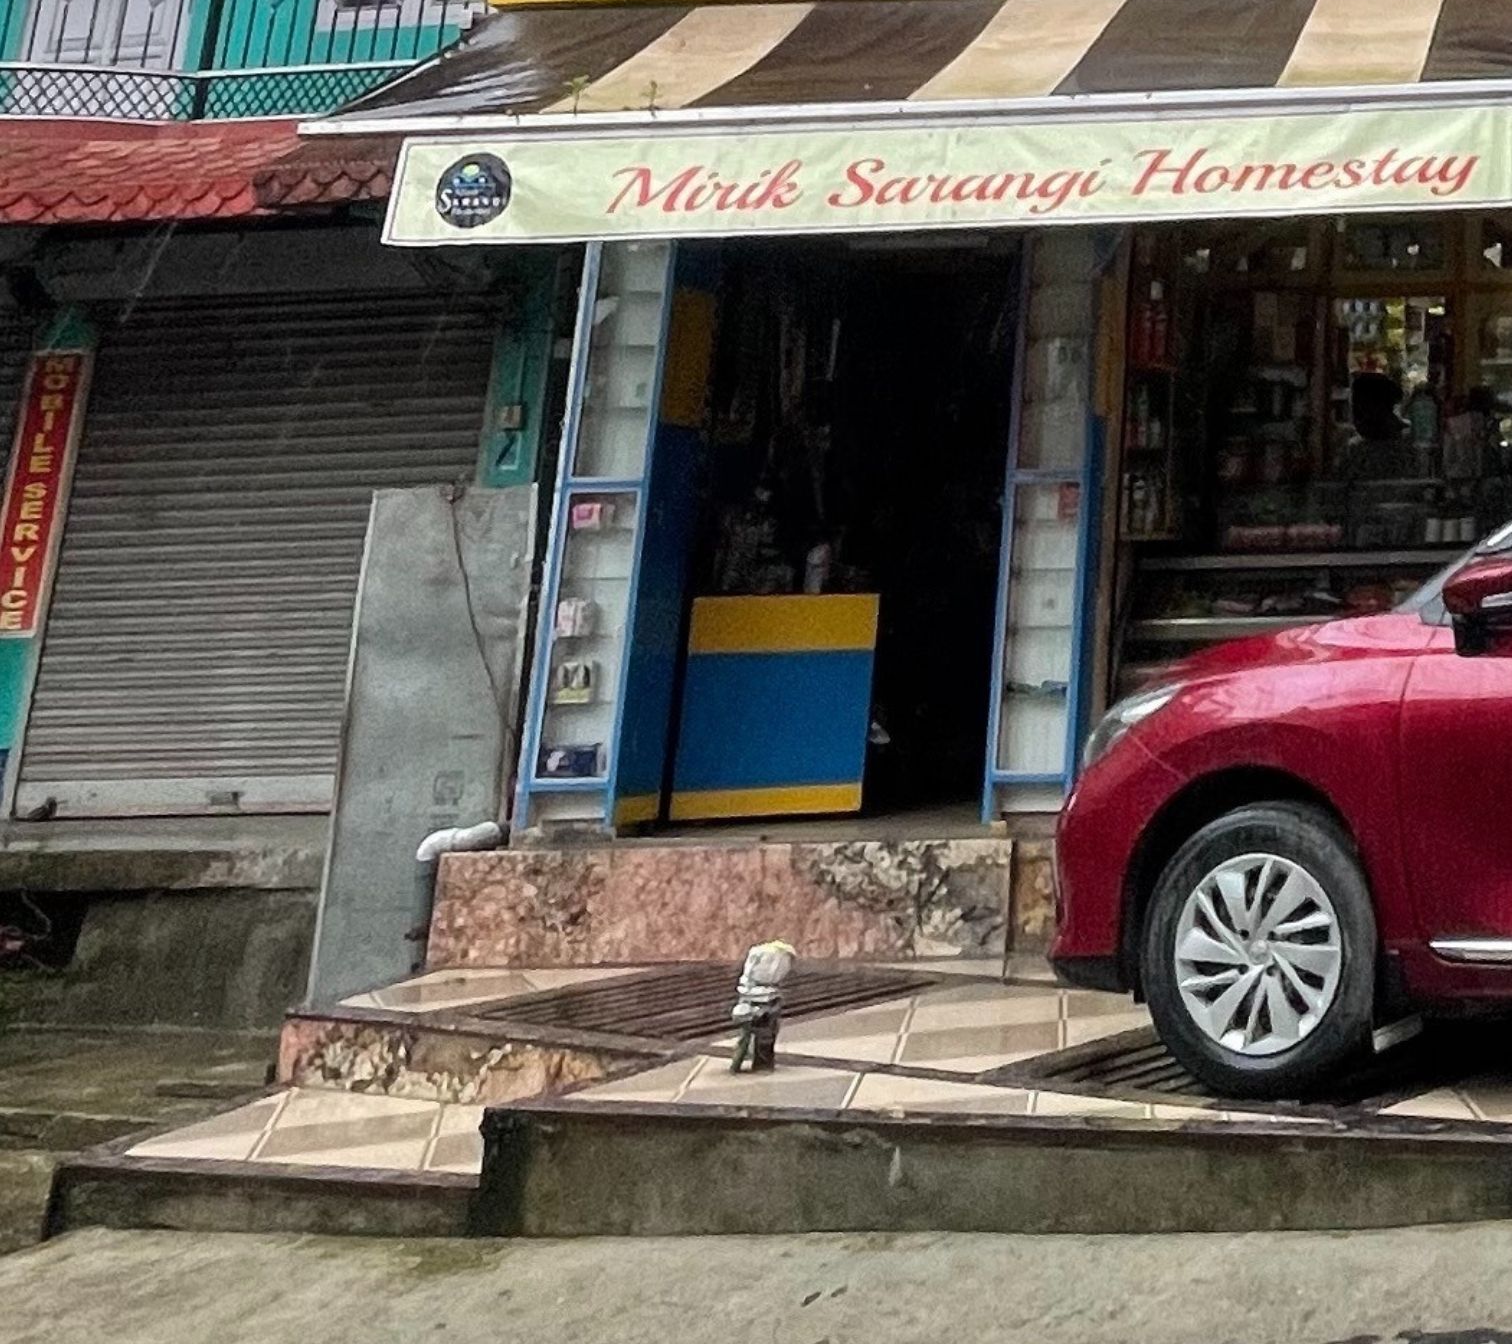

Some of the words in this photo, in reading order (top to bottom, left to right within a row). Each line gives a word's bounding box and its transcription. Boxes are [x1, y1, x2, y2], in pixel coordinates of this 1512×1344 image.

[605, 158, 804, 213] Mirik
[827, 157, 1112, 214] Sarangi
[1131, 147, 1481, 197] Homestay
[0, 481, 48, 629] SERVICE
